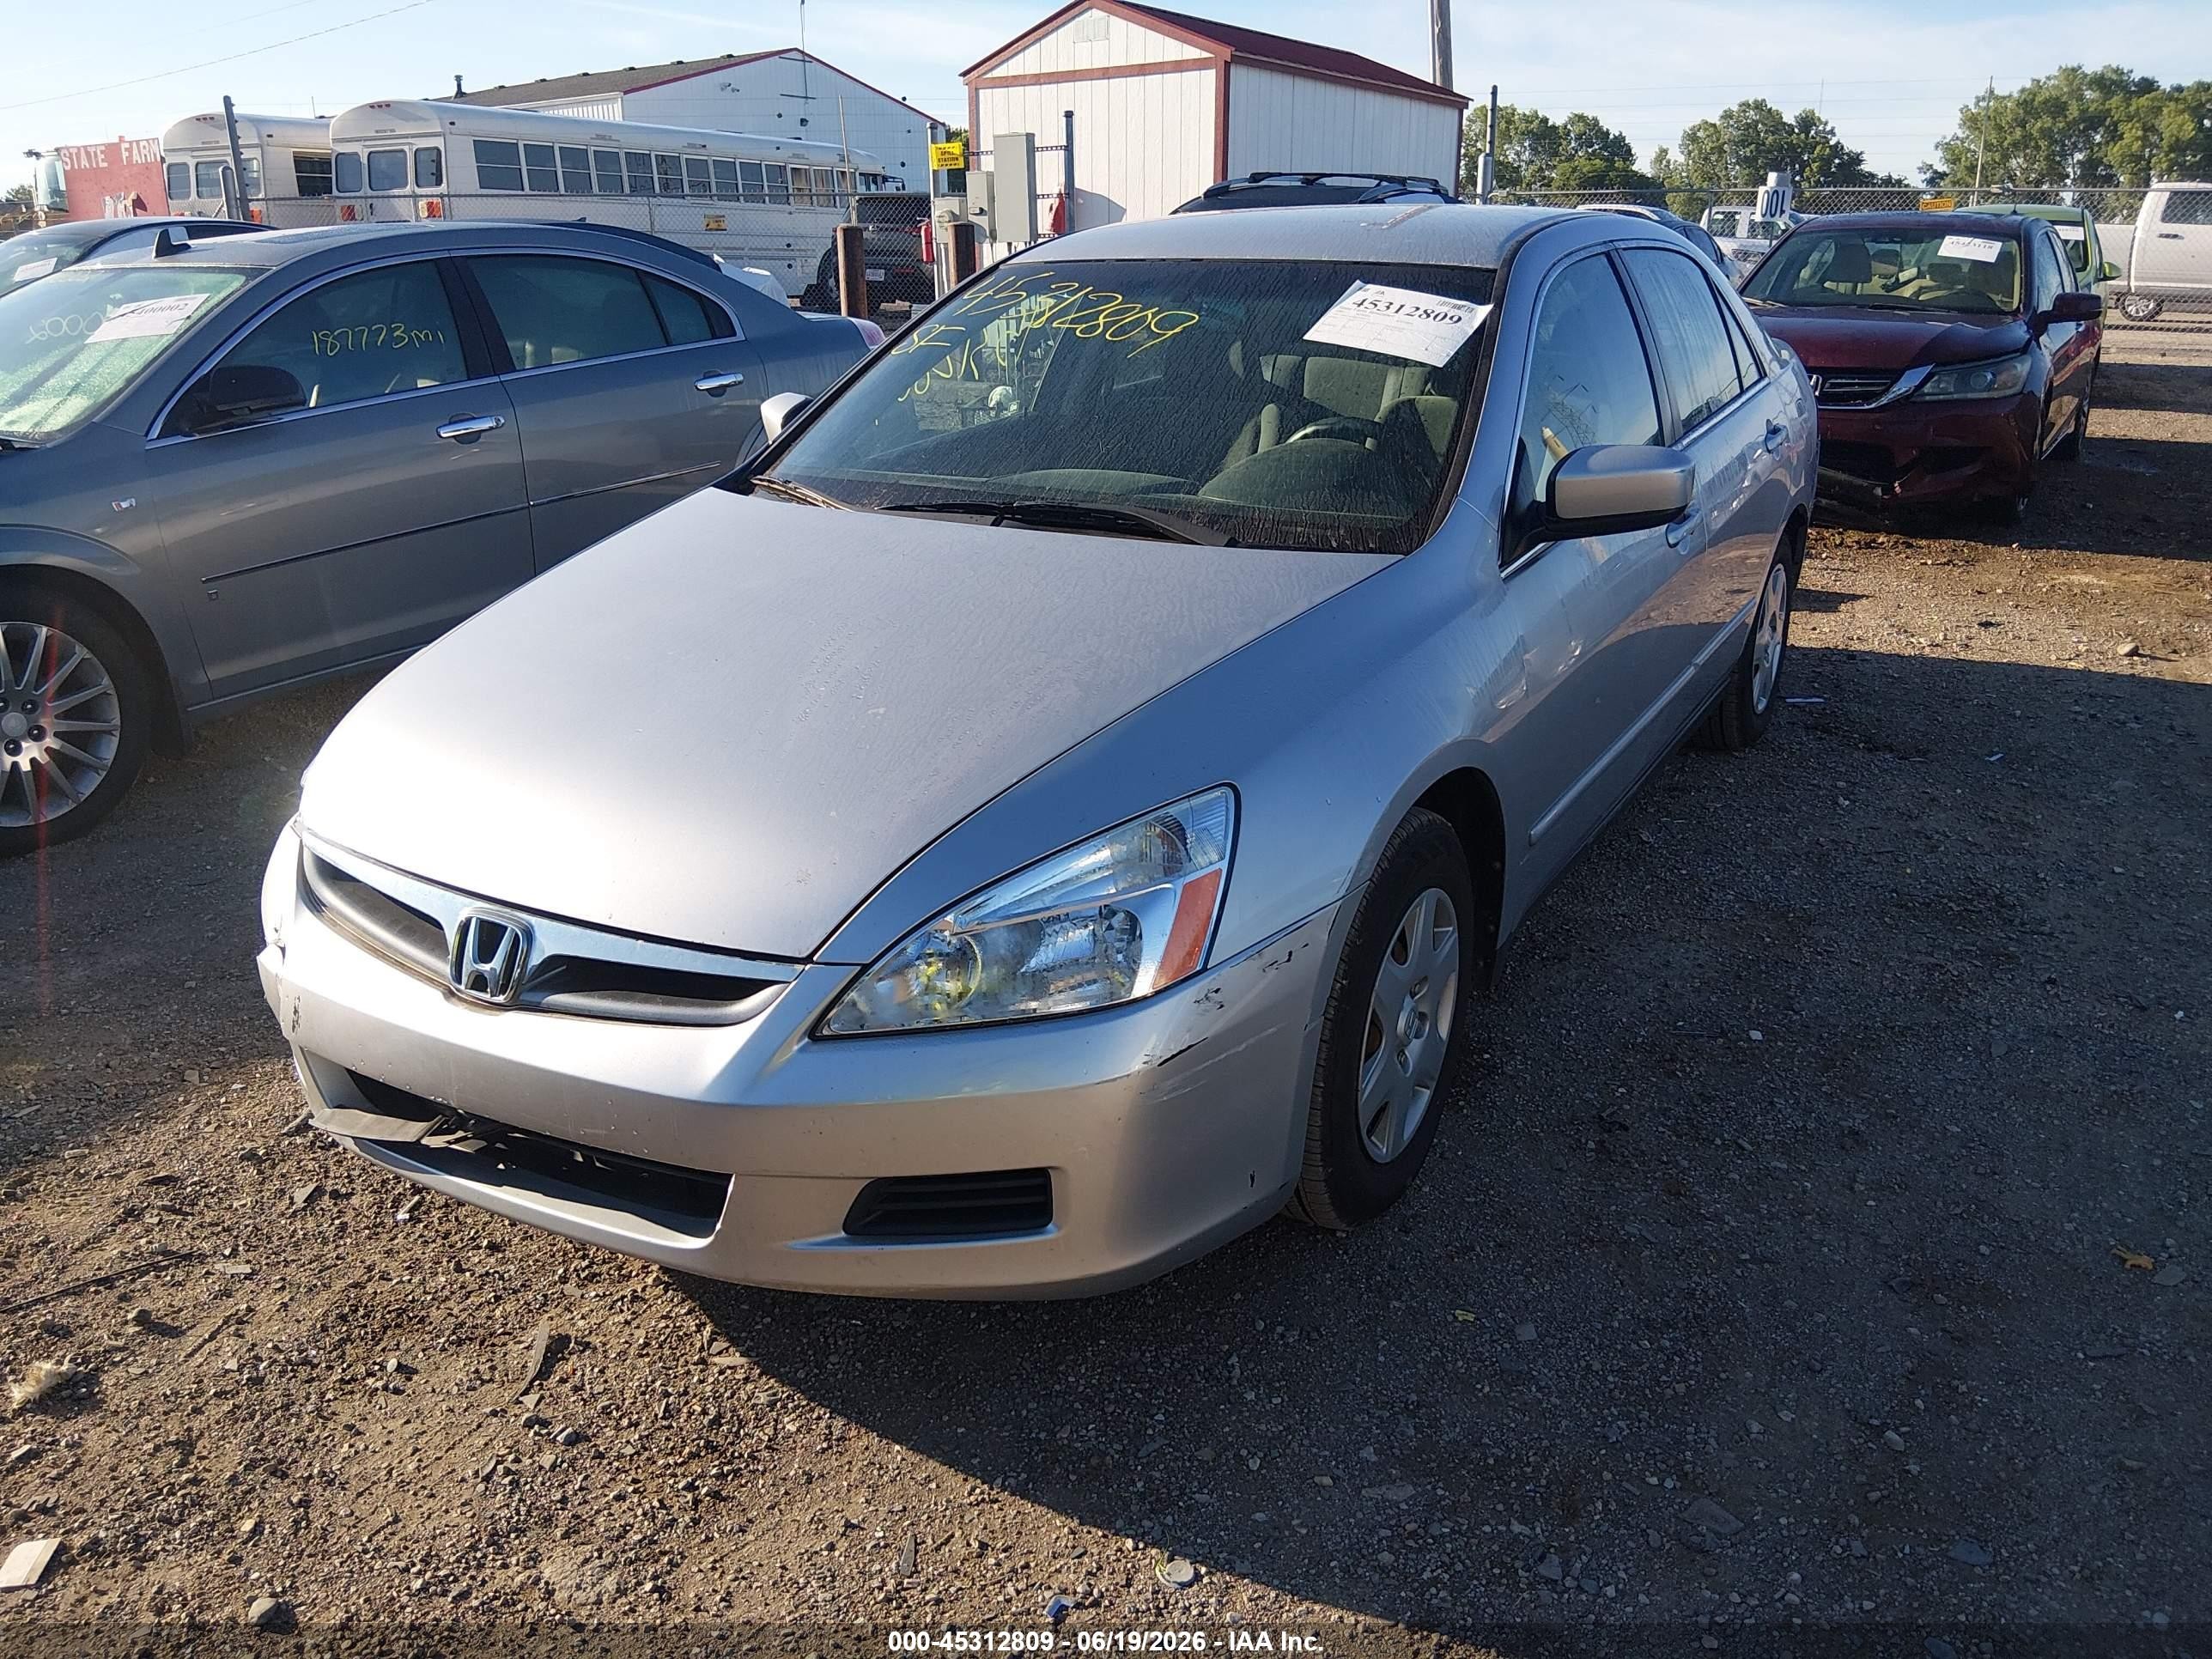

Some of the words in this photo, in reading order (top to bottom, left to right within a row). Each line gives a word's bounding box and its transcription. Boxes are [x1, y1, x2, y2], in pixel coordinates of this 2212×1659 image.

[60, 145, 108, 170] STATE
[120, 139, 161, 165] FARM
[1923, 199, 1952, 209] CAUTION
[1352, 297, 1462, 325] 45312809
